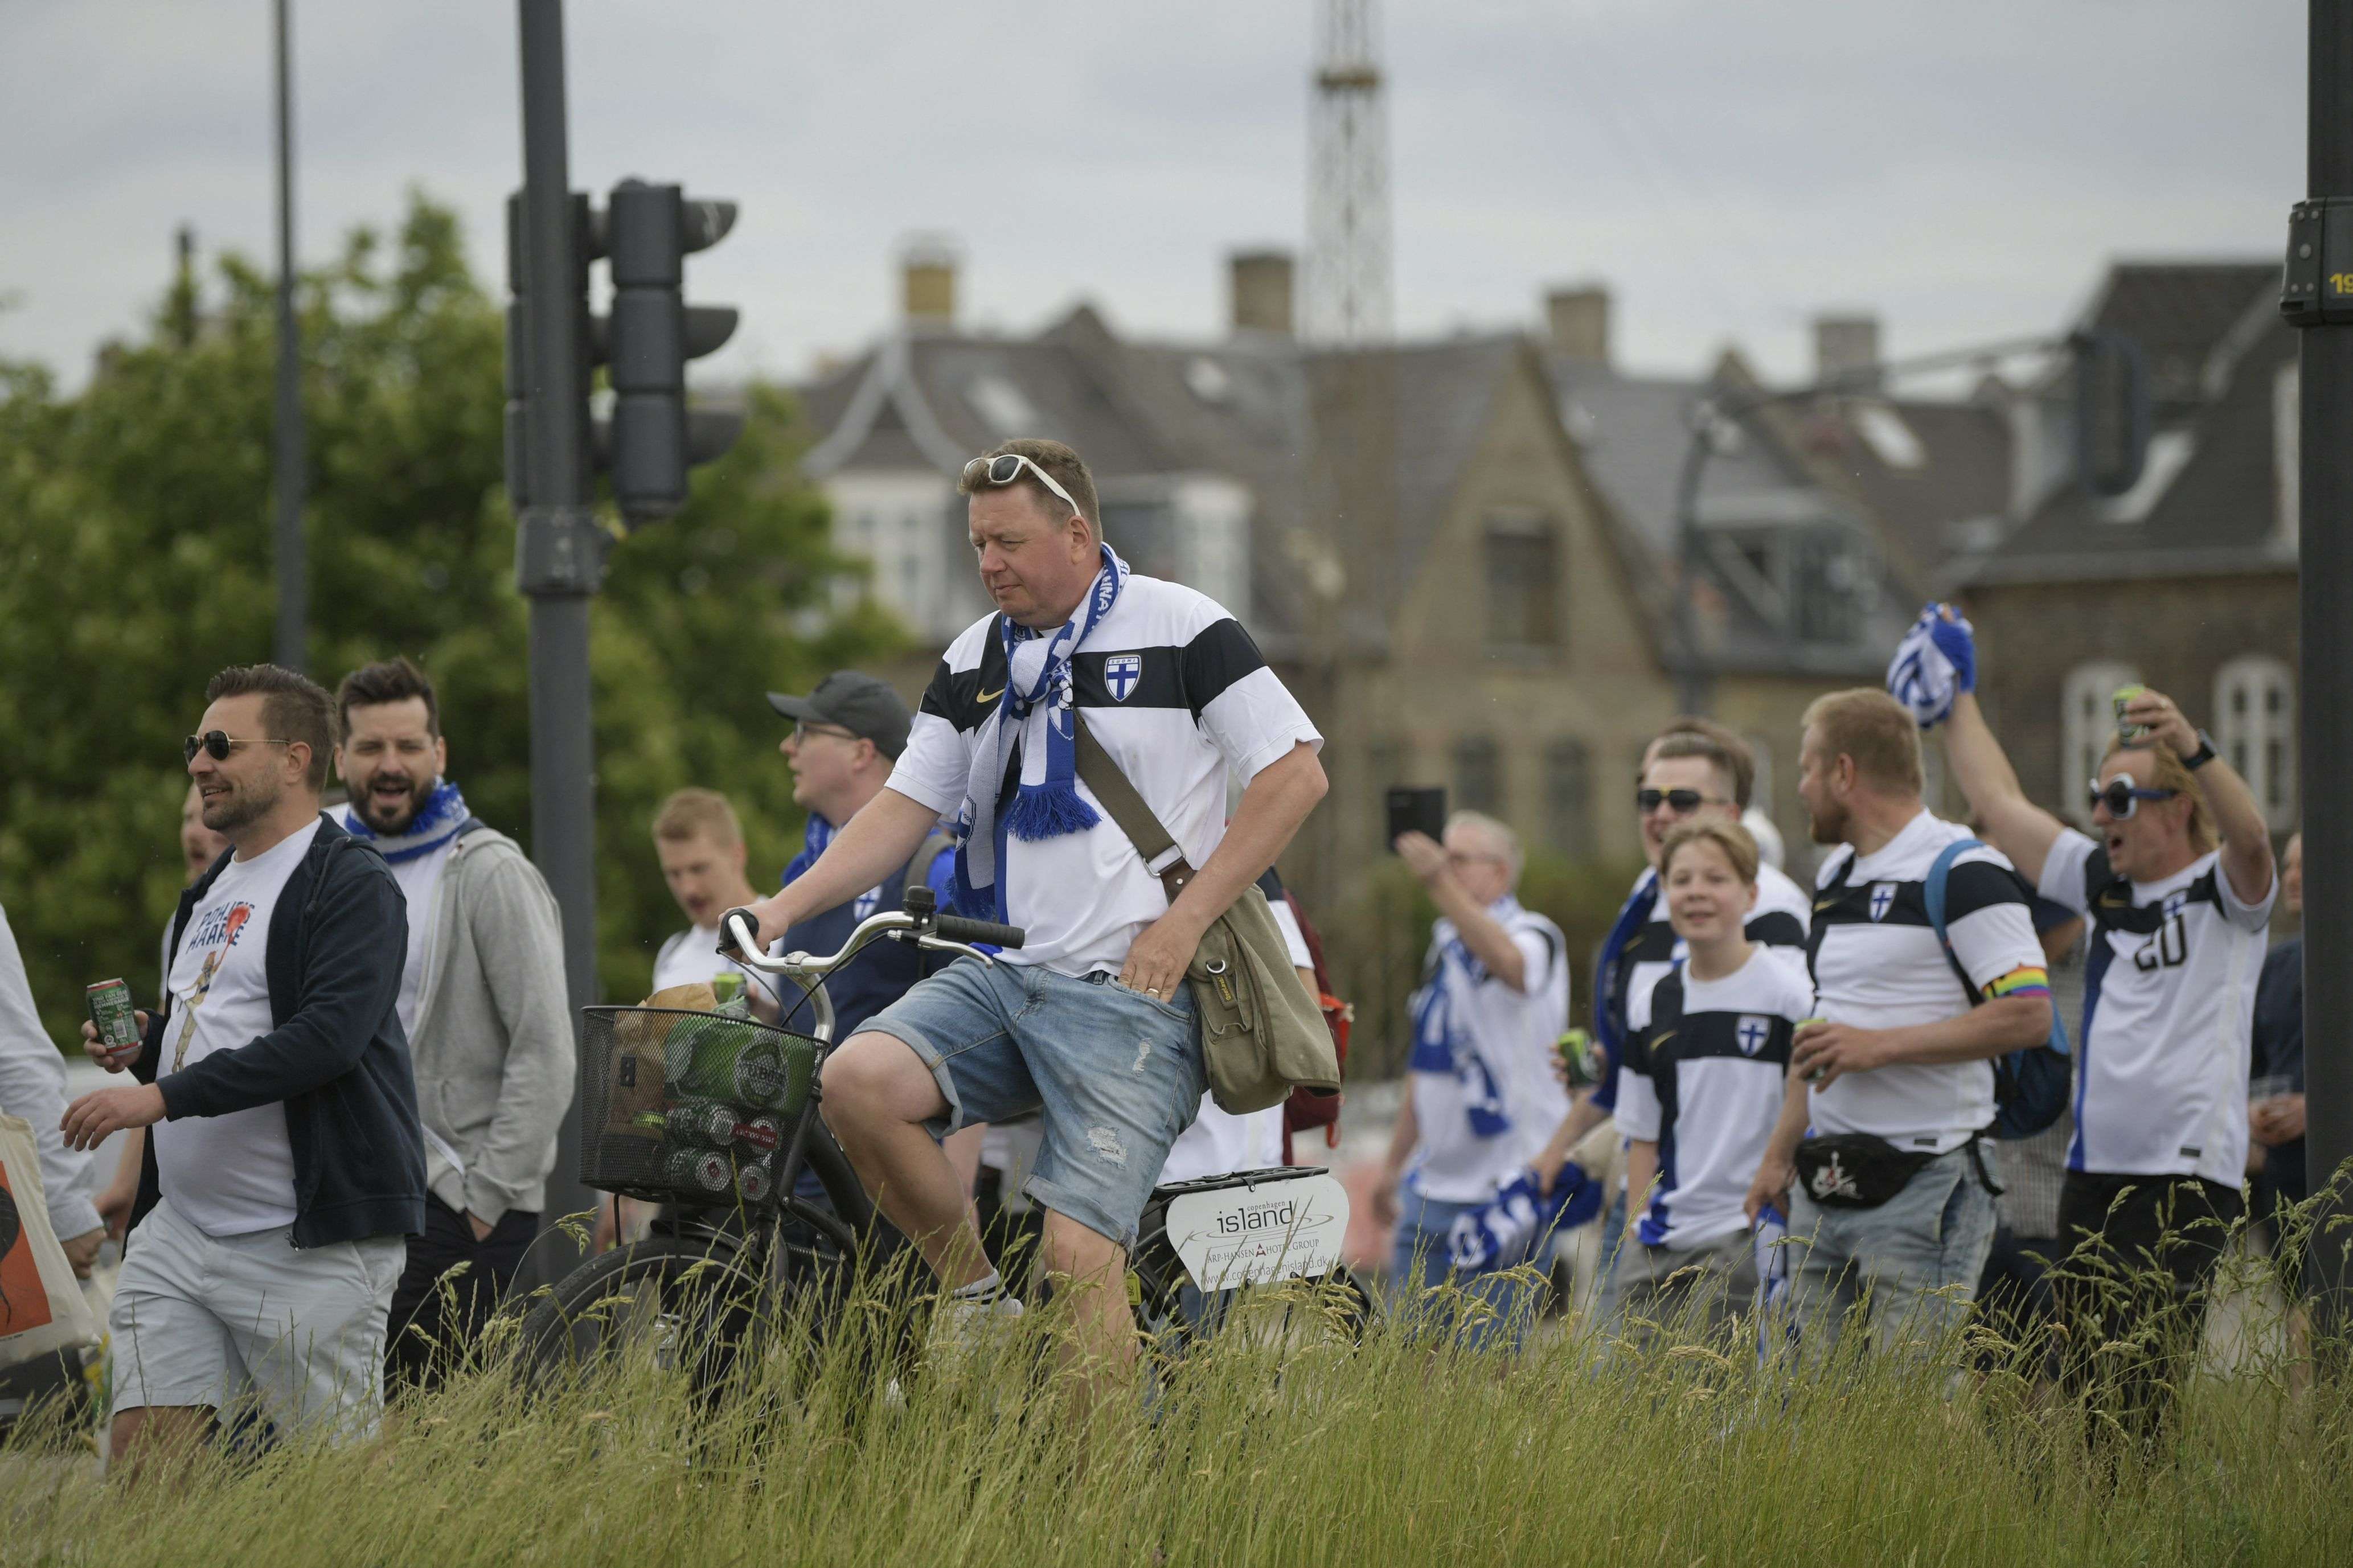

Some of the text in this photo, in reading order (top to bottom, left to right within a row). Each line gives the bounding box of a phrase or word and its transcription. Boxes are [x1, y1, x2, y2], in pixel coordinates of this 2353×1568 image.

[2134, 914, 2188, 972] 20
[1217, 1201, 1294, 1233] island
[1247, 1201, 1286, 1212] copenhagen
[1208, 1248, 1255, 1263] ARP-HANSEN
[1292, 1239, 1319, 1250] GROUP
[1206, 1255, 1327, 1284] www.coenhagnisland.dk
